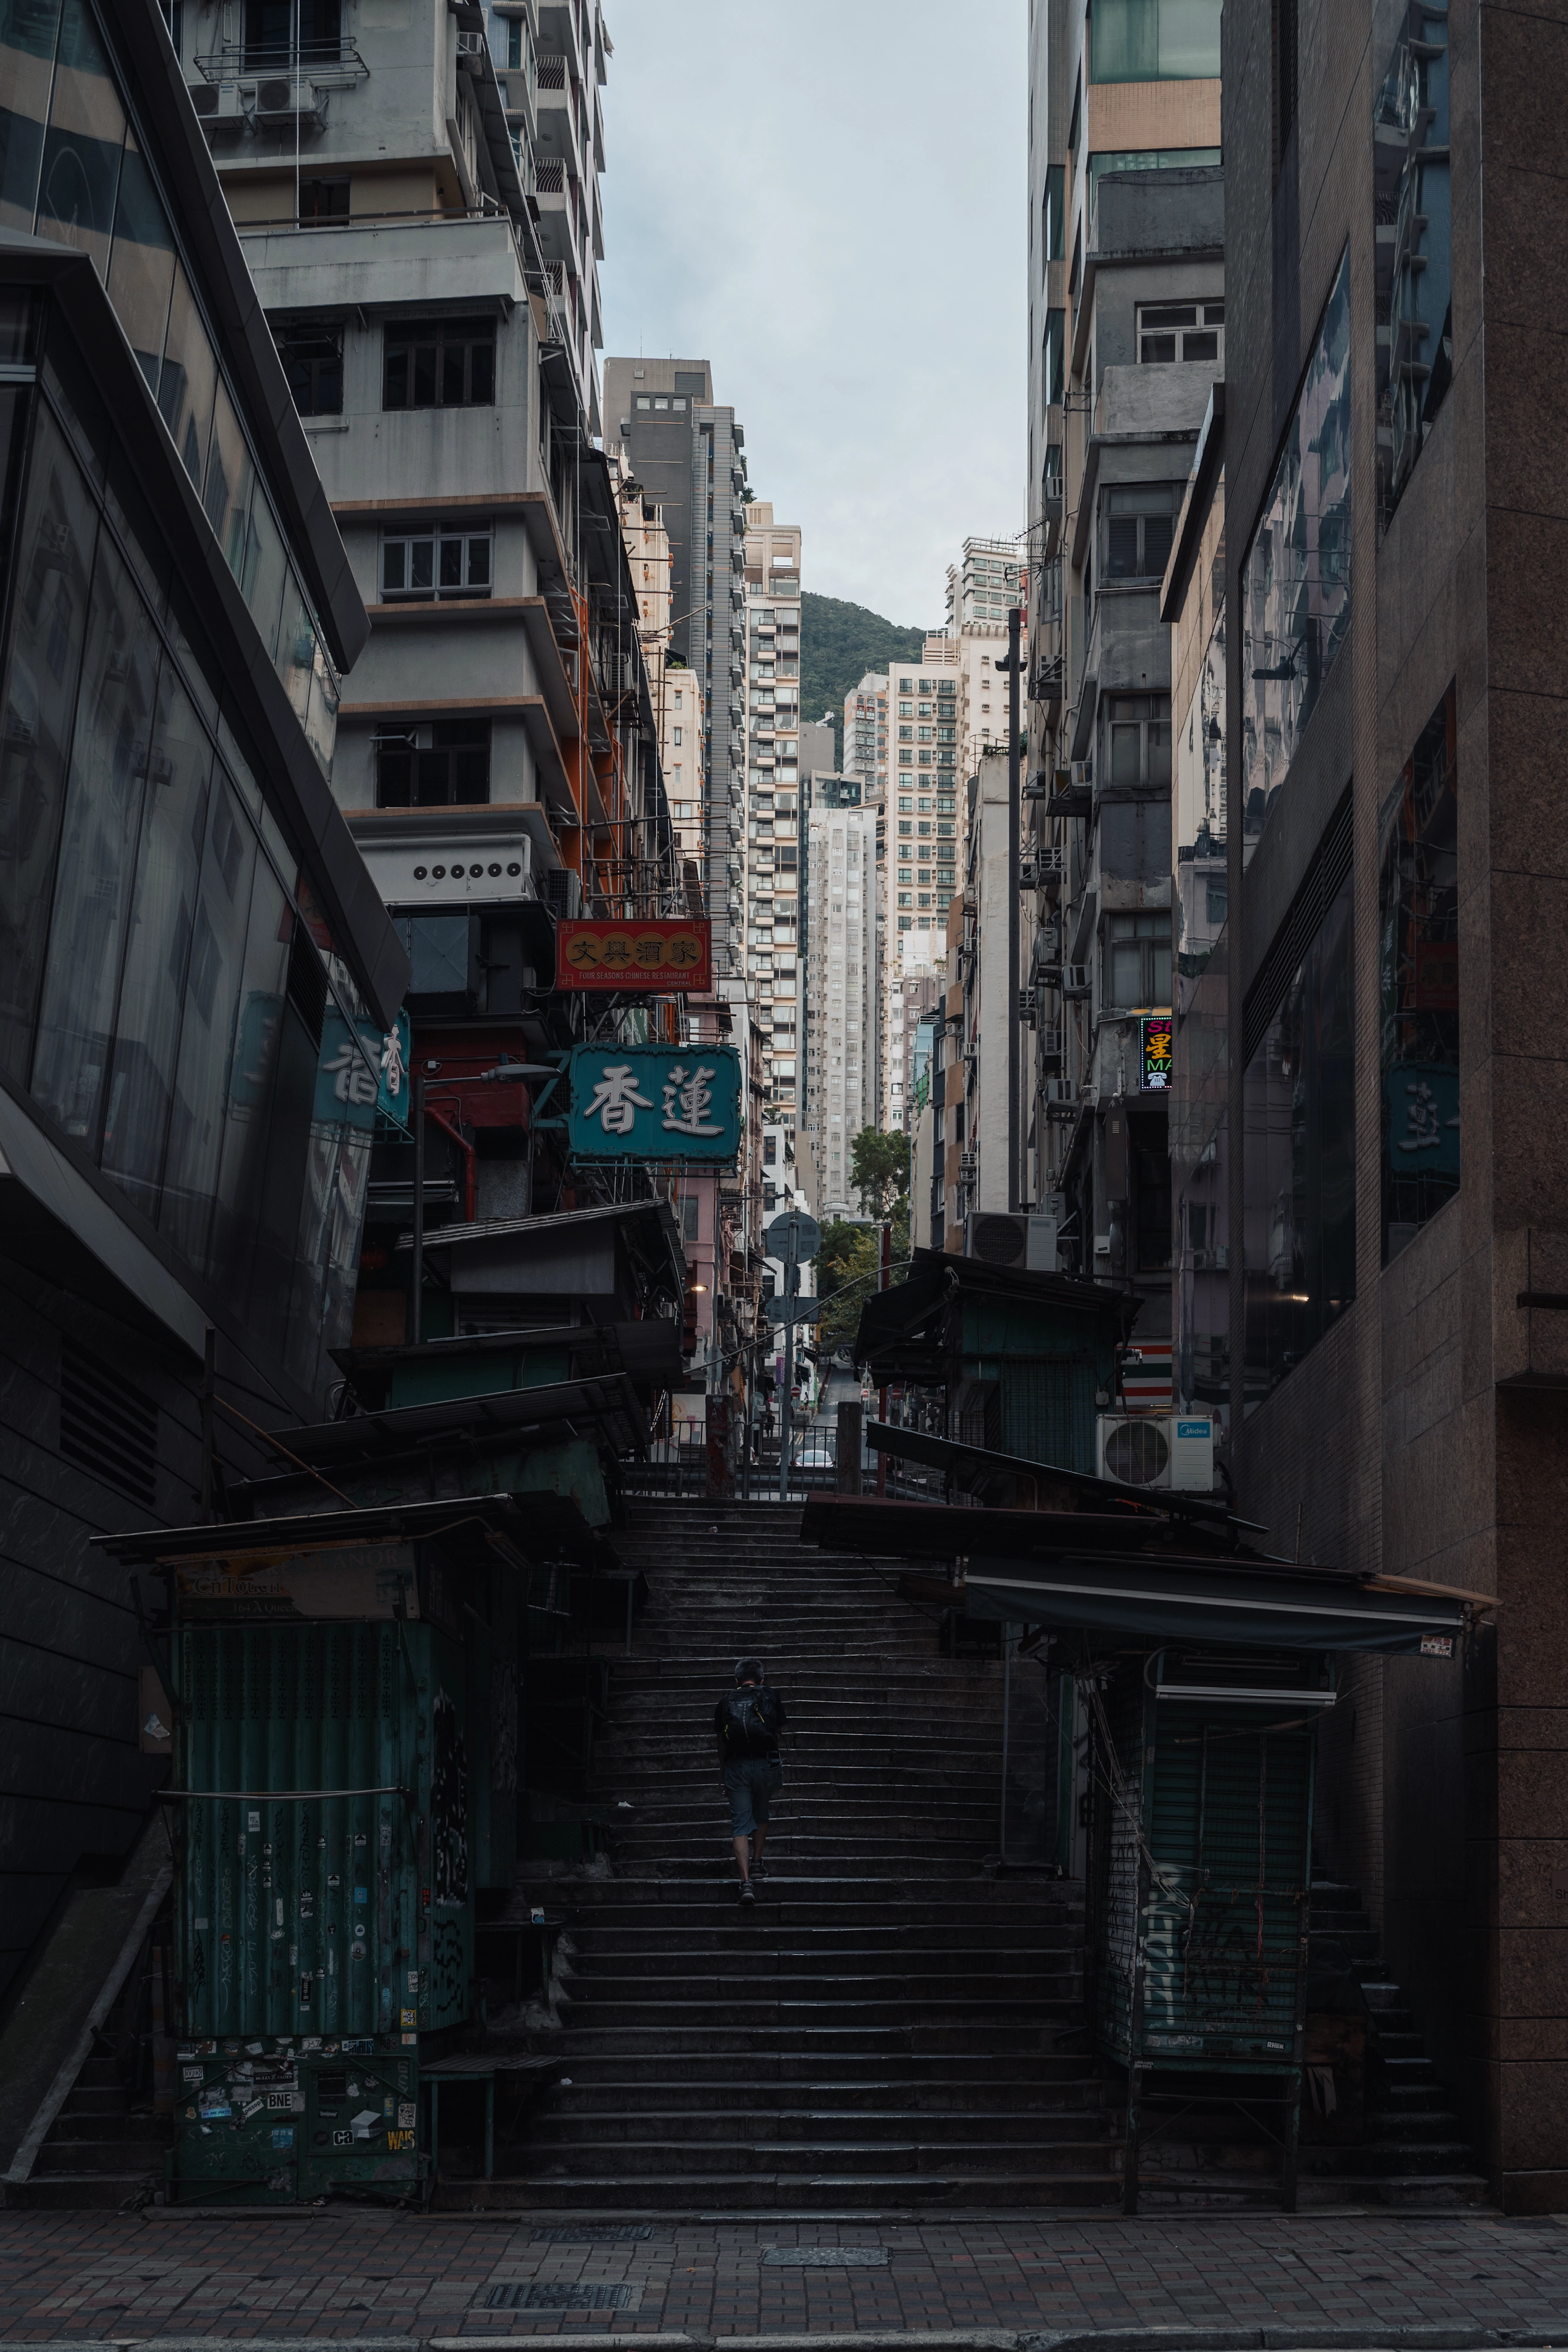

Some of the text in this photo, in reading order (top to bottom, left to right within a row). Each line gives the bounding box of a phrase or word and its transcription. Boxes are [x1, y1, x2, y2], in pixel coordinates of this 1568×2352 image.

[571, 940, 698, 964] 文興酒家
[625, 971, 650, 980] CHINESE
[1146, 1033, 1172, 1059] 星
[1183, 1426, 1207, 1435] Midea
[269, 2094, 291, 2107] BNE
